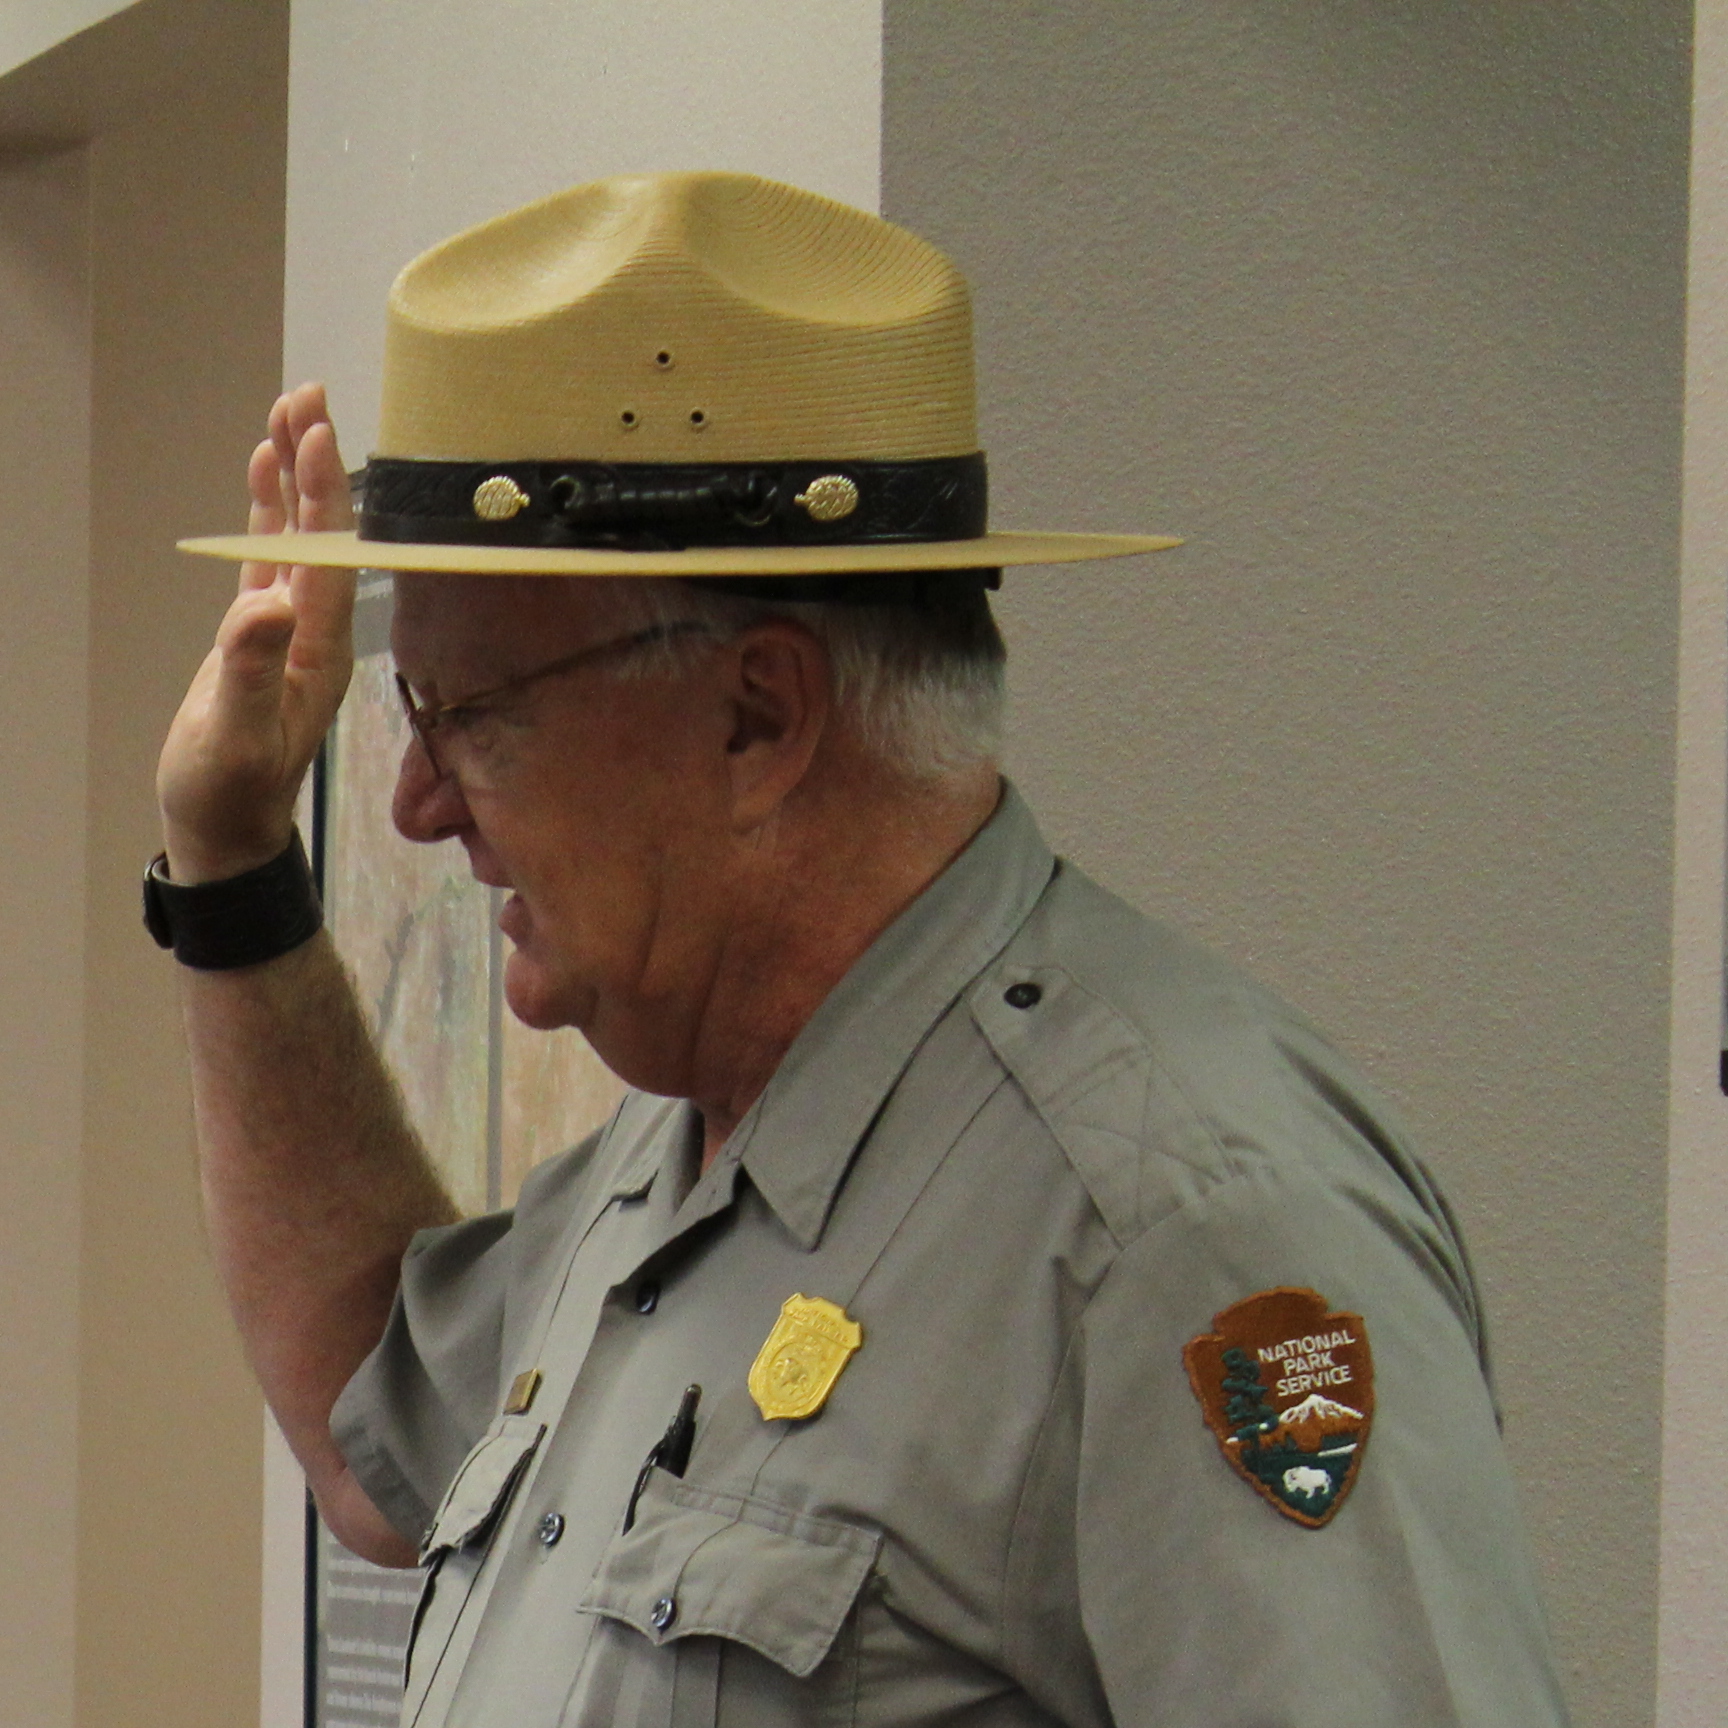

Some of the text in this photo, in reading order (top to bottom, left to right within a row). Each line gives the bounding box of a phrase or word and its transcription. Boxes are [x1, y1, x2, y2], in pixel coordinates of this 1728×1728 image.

[1257, 1329, 1356, 1362] NATIONAL
[1283, 1350, 1336, 1376] PARK
[1276, 1365, 1353, 1396] SERVICE
